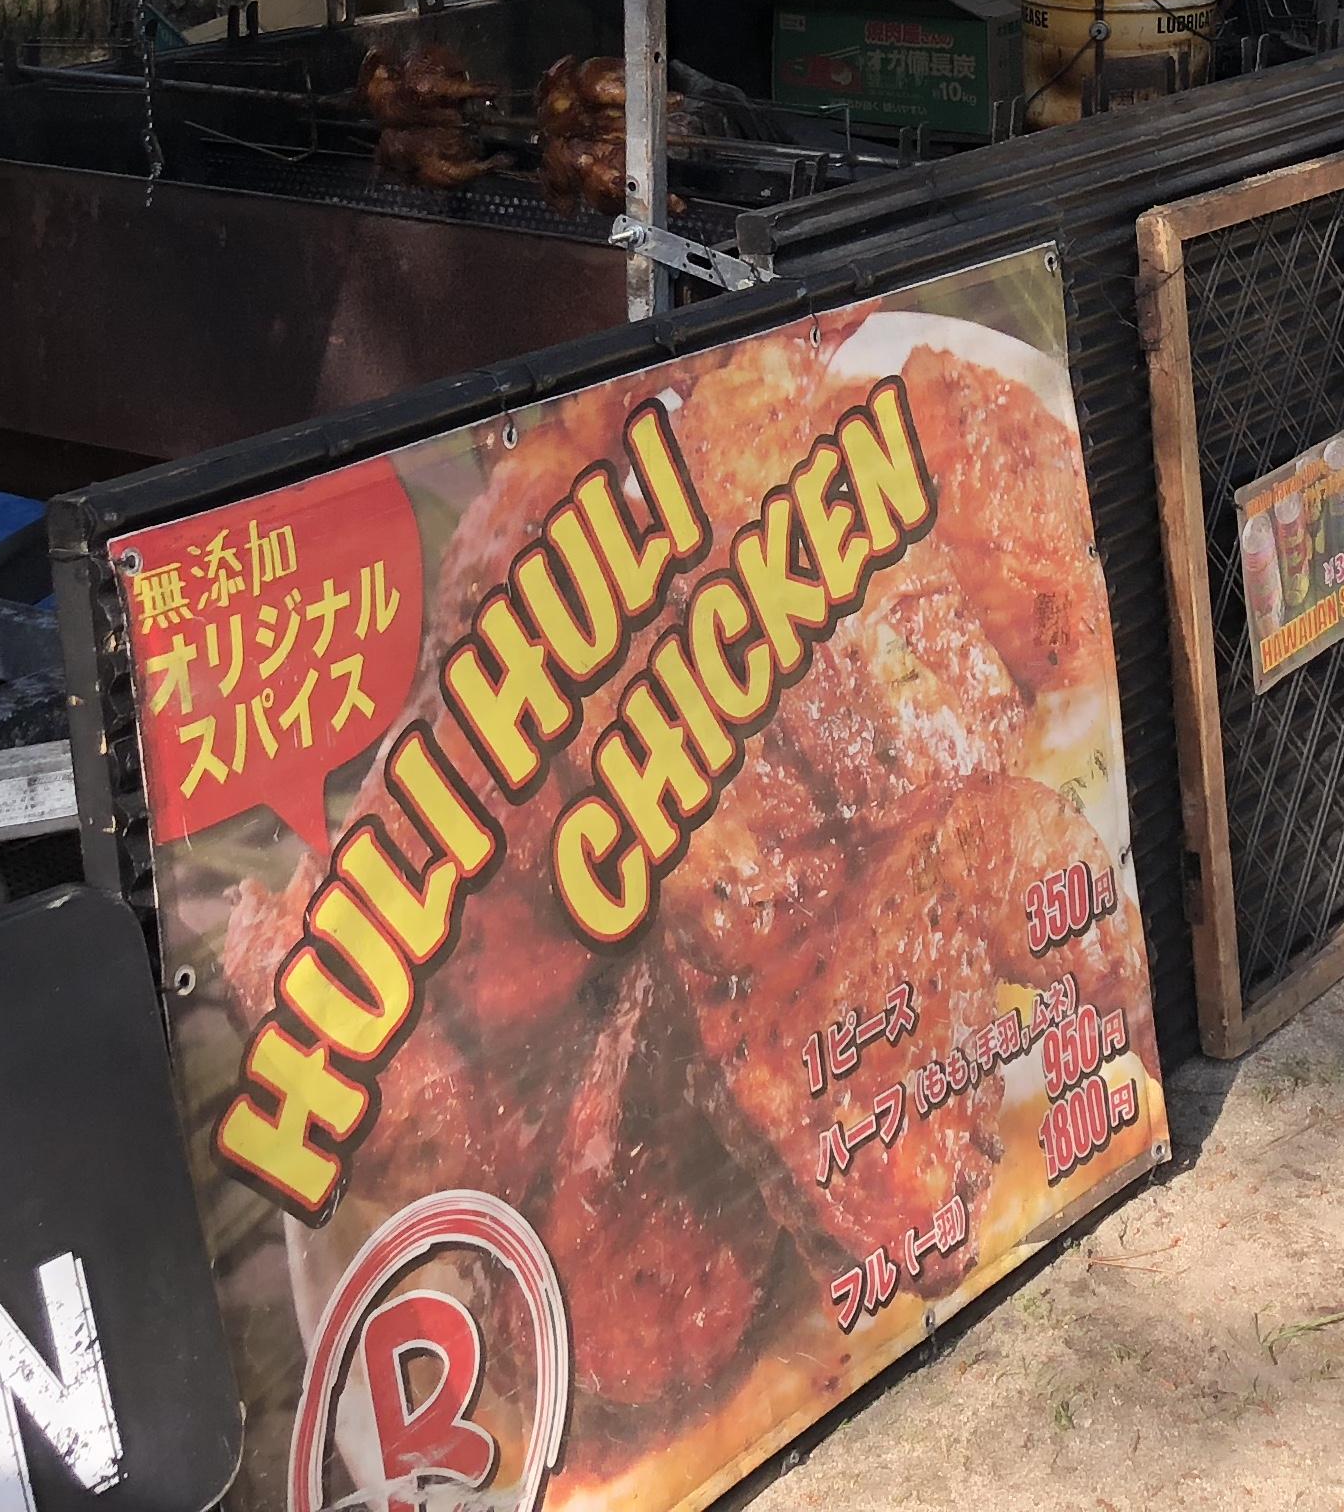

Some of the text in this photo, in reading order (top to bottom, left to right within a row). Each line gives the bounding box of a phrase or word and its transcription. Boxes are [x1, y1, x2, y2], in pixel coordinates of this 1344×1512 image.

[134, 519, 298, 634] 無添加
[146, 560, 401, 716] オリジナル
[1260, 591, 1339, 673] HAWAIIAN
[179, 653, 375, 799] スパイス
[554, 378, 936, 948] CHICKEN
[216, 402, 706, 1216] HULI HULI
[802, 861, 1115, 1092] 1ピース 350円
[1042, 1005, 1126, 1096] 950円
[1041, 1076, 1136, 1179] 1800円
